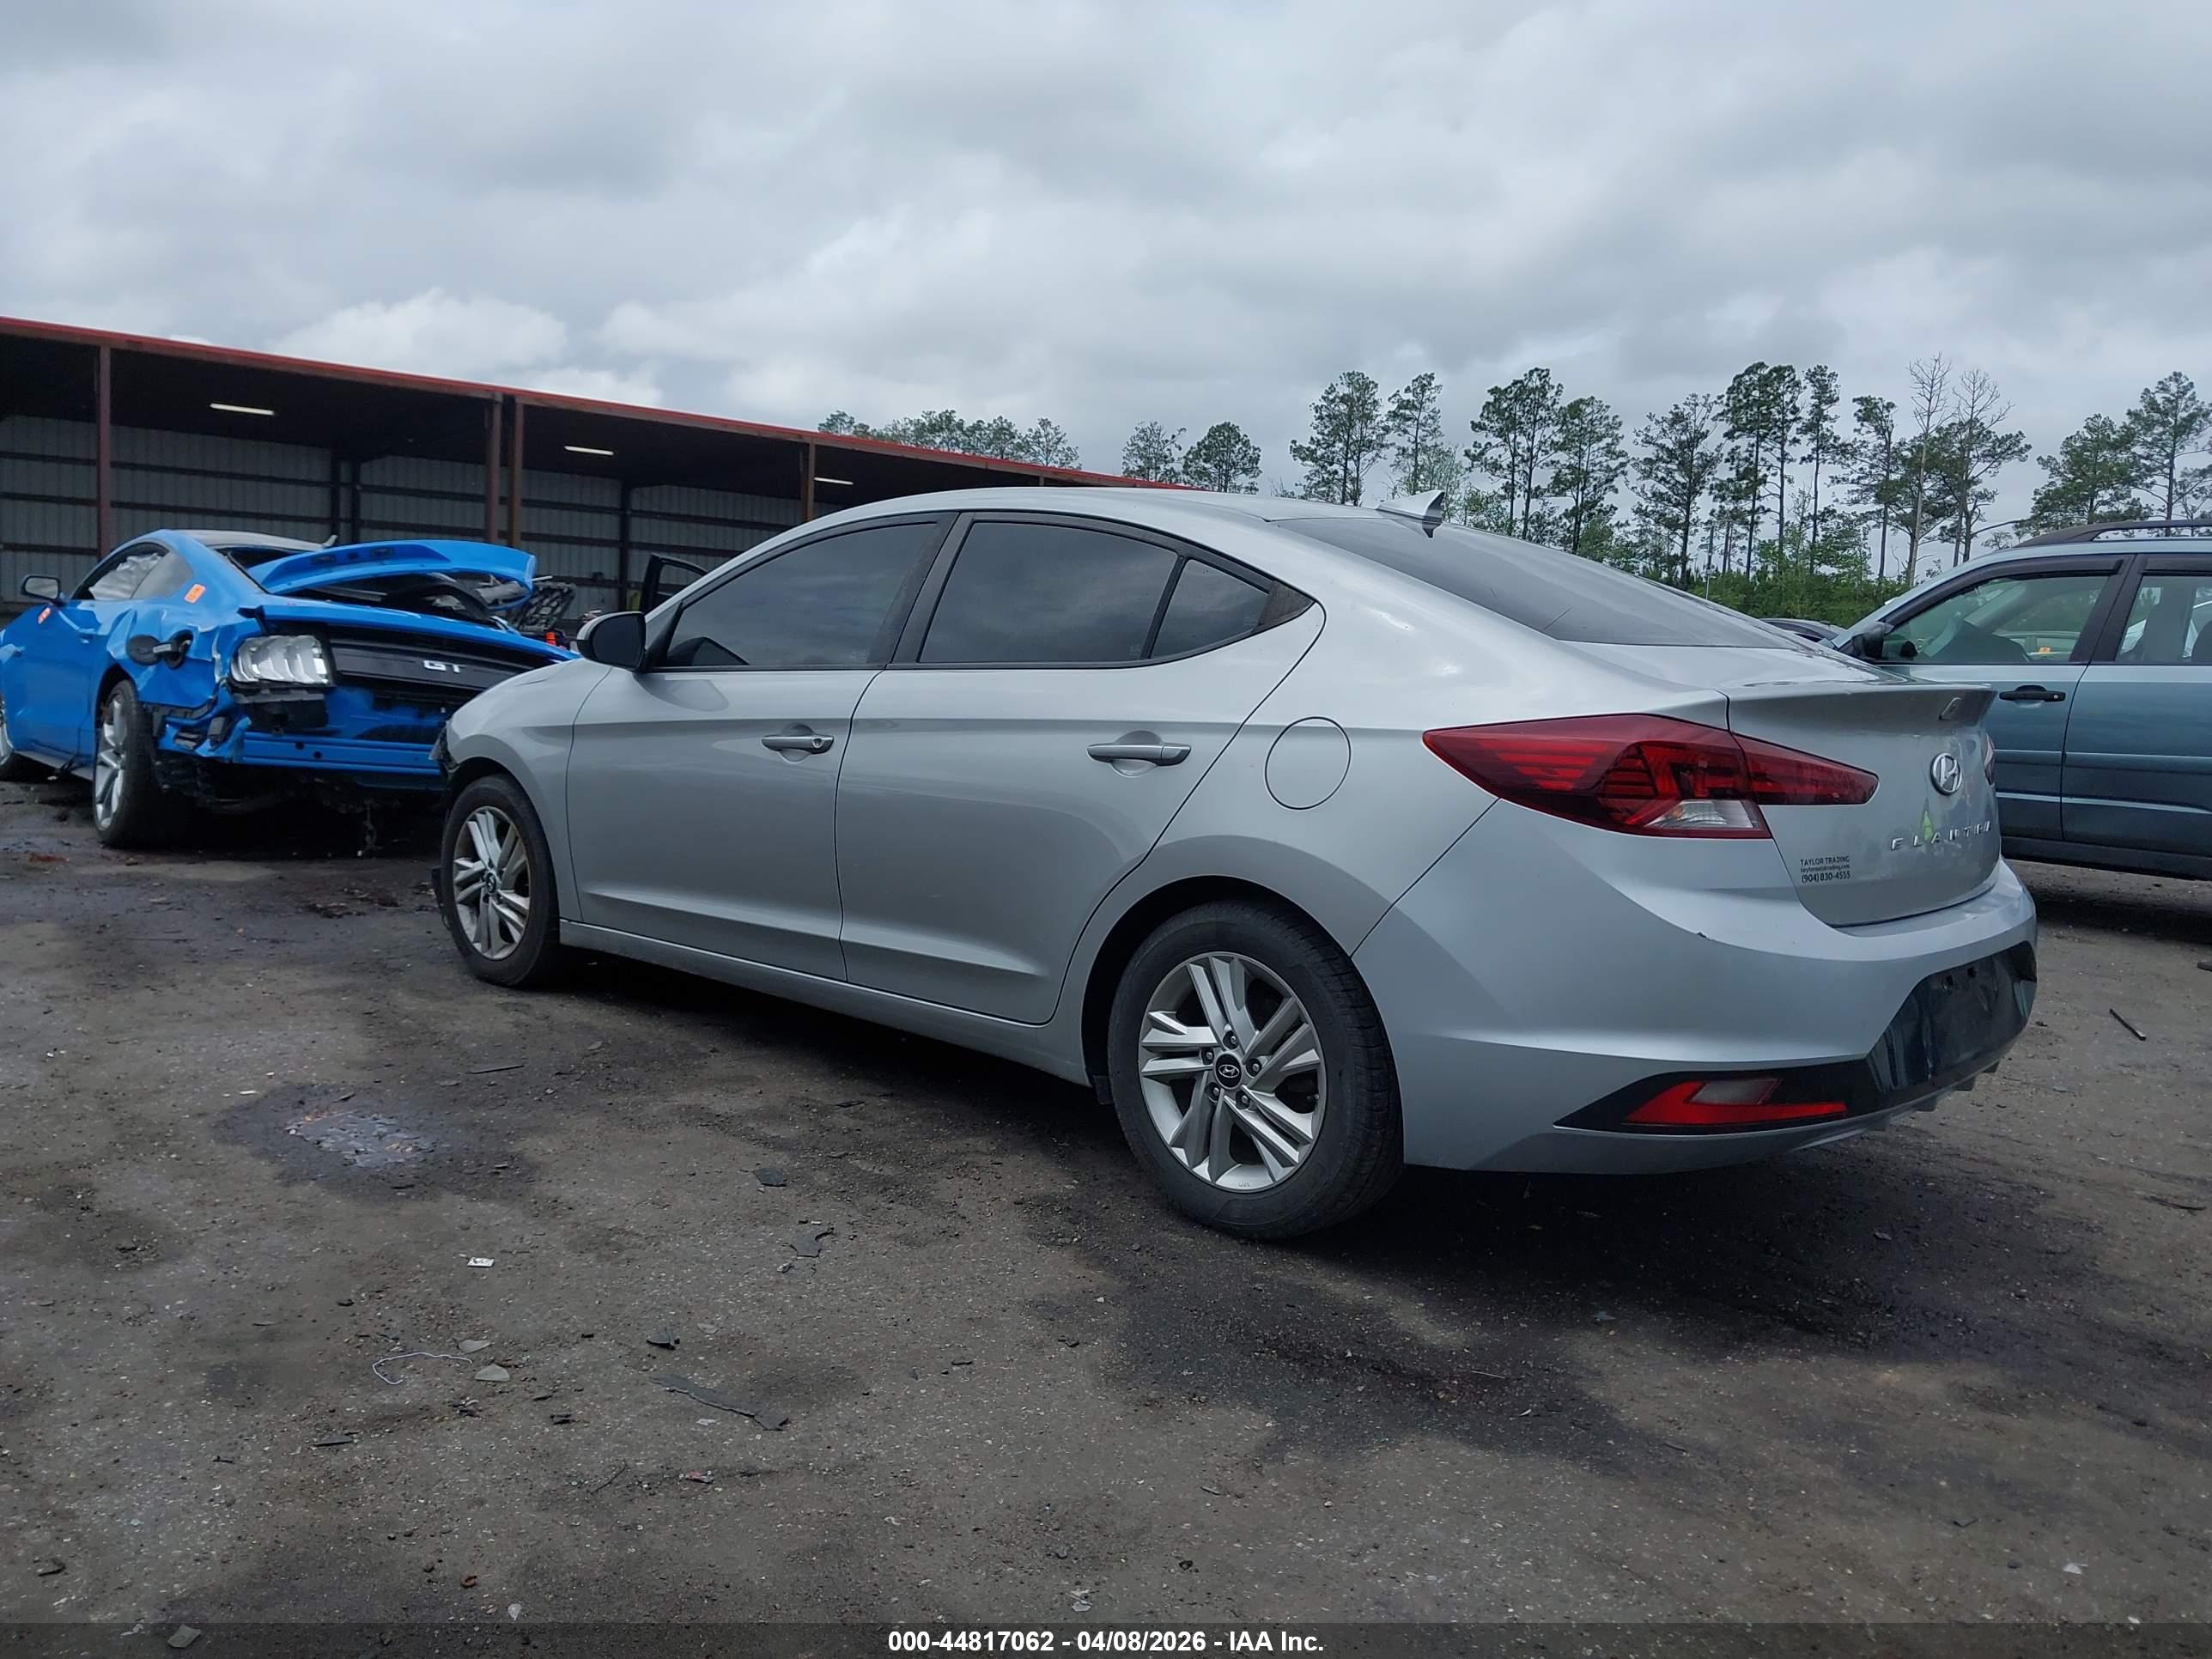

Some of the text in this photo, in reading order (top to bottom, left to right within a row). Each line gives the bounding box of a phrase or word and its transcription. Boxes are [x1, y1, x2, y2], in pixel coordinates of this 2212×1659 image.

[423, 659, 467, 673] GT
[1800, 855, 1850, 866] TAYLOR TRADING
